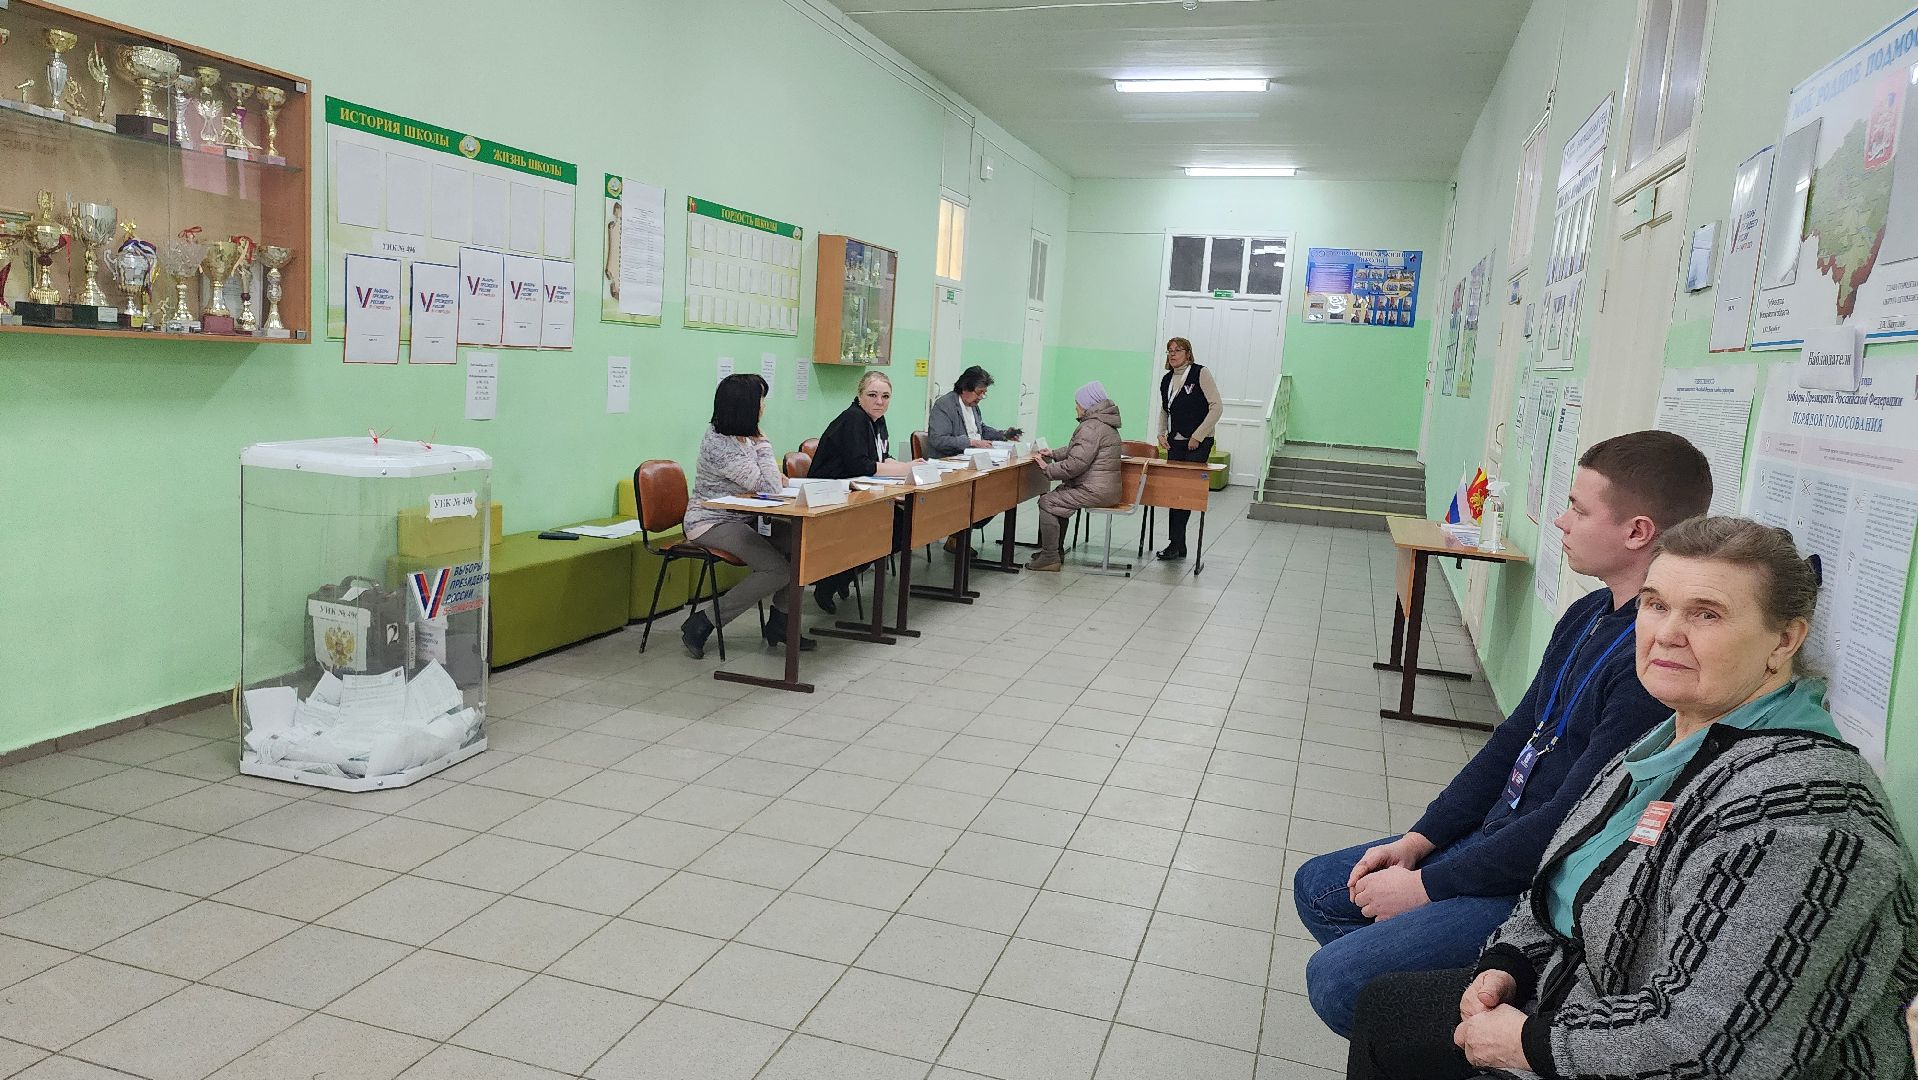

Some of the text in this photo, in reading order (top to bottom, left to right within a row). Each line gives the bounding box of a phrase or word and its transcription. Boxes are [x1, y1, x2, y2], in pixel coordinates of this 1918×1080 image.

[340, 107, 449, 148] ИСТОРИЯ ШКОЛЫ
[493, 148, 562, 177] ЖИЗНЬ ШКОЛЫ
[721, 208, 778, 232] ГОРДОСТЬ ШКОЛЫ
[1807, 351, 1852, 367] Наблюдатели
[1835, 391, 1868, 405] Российской
[1791, 412, 1884, 433] ПОРЯДОК ГОЛОСОВАНИЯ
[462, 497, 473, 505] 496
[454, 562, 483, 577] ВЫБОРЫ
[445, 589, 474, 604] РОССИИ
